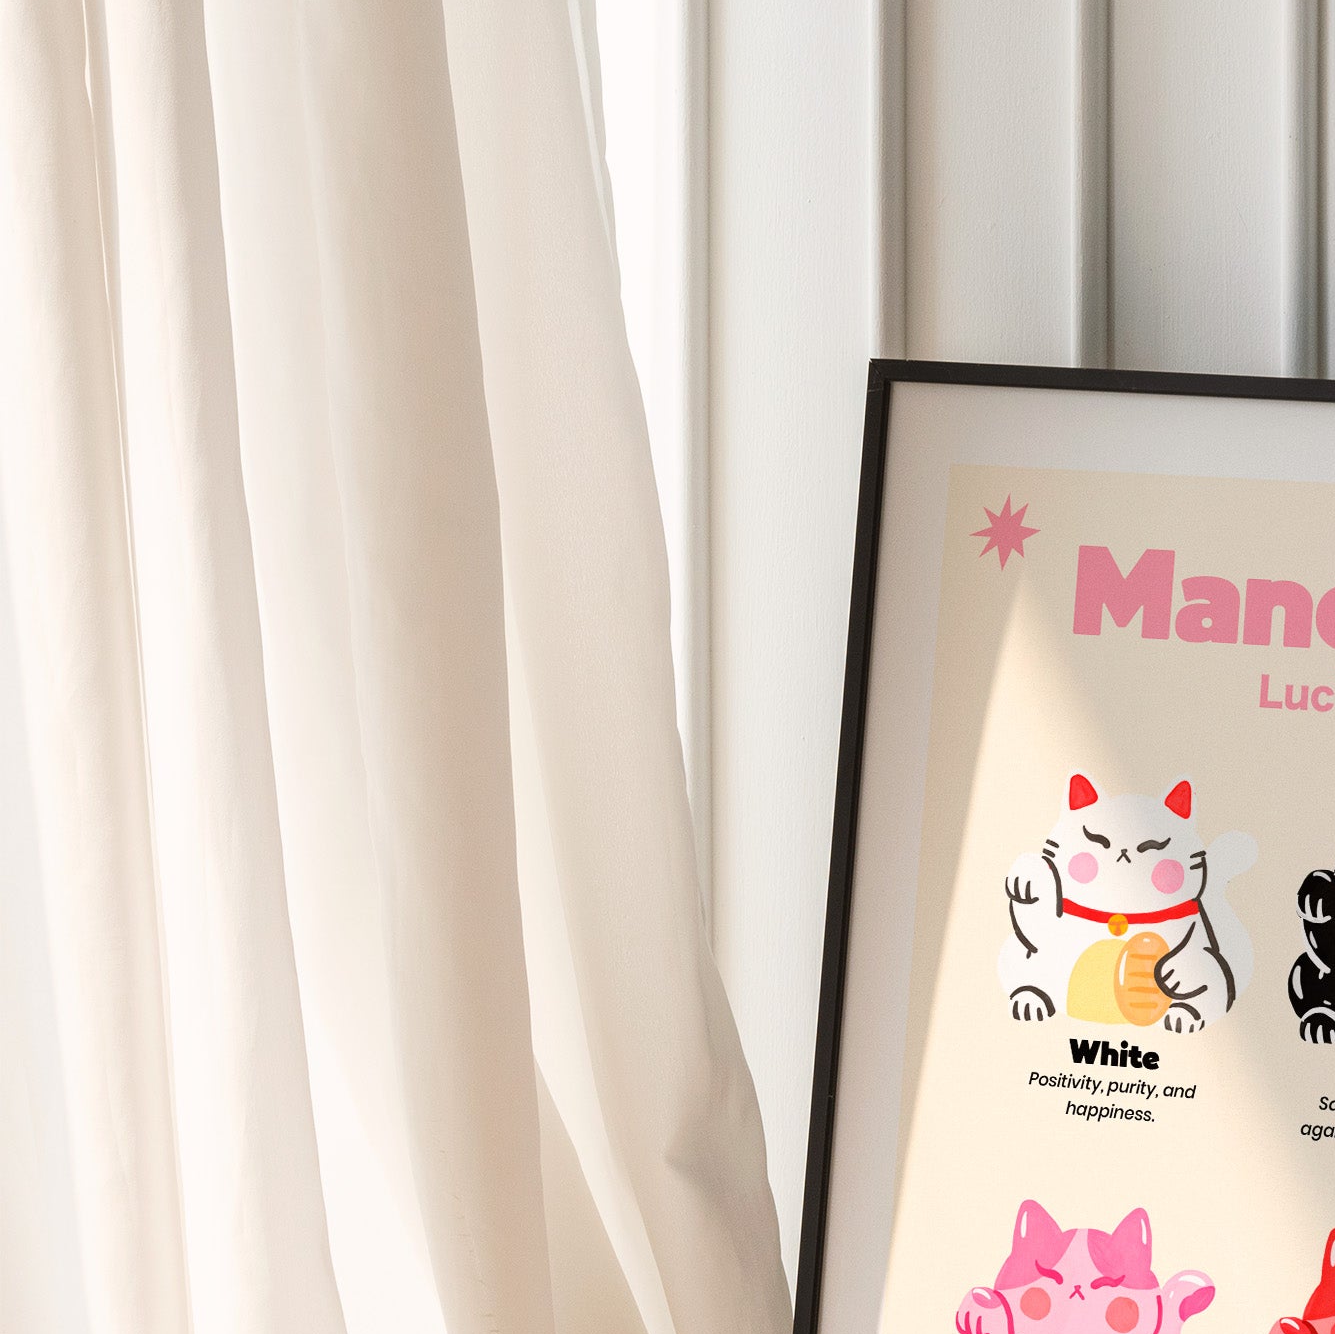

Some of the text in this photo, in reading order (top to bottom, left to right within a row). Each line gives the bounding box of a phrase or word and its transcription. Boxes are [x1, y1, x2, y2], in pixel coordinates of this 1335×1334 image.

[1069, 1038, 1160, 1071] White
[1028, 1071, 1197, 1100] Positivity, purity, and
[1065, 1100, 1155, 1122] happiness.
